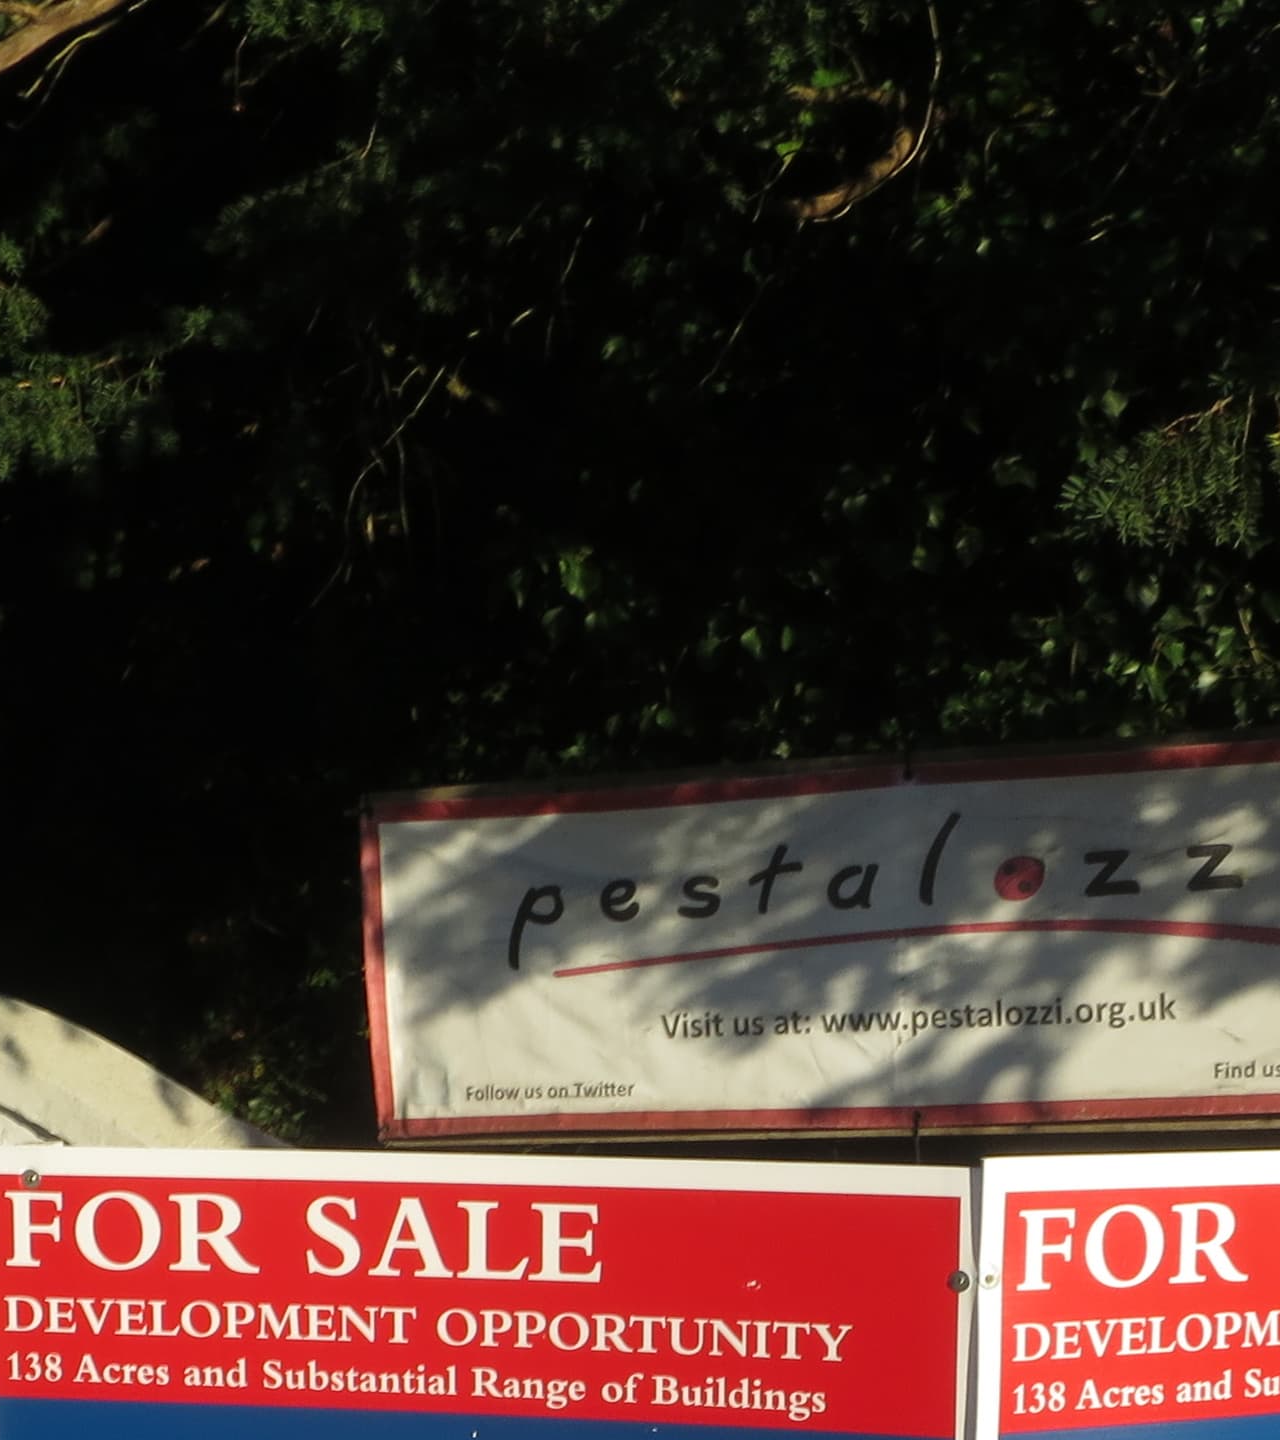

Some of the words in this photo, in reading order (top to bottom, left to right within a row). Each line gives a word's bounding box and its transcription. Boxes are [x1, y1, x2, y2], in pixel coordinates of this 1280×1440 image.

[662, 1009, 724, 1040] Visit
[733, 1015, 765, 1036] us
[773, 1011, 811, 1036] at:
[821, 993, 1177, 1037] www.pestalozzi.org.uk
[466, 1084, 520, 1102] Follow
[524, 1086, 543, 1100] us
[549, 1086, 569, 1099] on
[573, 1081, 635, 1098] Twitter
[1213, 1060, 1256, 1079] Find
[5, 1188, 261, 1275] FOR
[305, 1194, 603, 1285] SALE
[1016, 1201, 1248, 1293] FOR
[4, 1294, 416, 1346] DEVELOPMENT
[436, 1305, 852, 1363] OPPORTUNITY
[5, 1352, 64, 1384] 138
[73, 1356, 170, 1389] Acres
[182, 1358, 247, 1390] and
[262, 1360, 457, 1397] Substantial
[470, 1367, 586, 1406] Range
[601, 1371, 639, 1403] of
[651, 1375, 827, 1421] Buildings
[1012, 1381, 1066, 1416] 138
[1075, 1378, 1164, 1412] Acres
[1176, 1371, 1232, 1404] and
